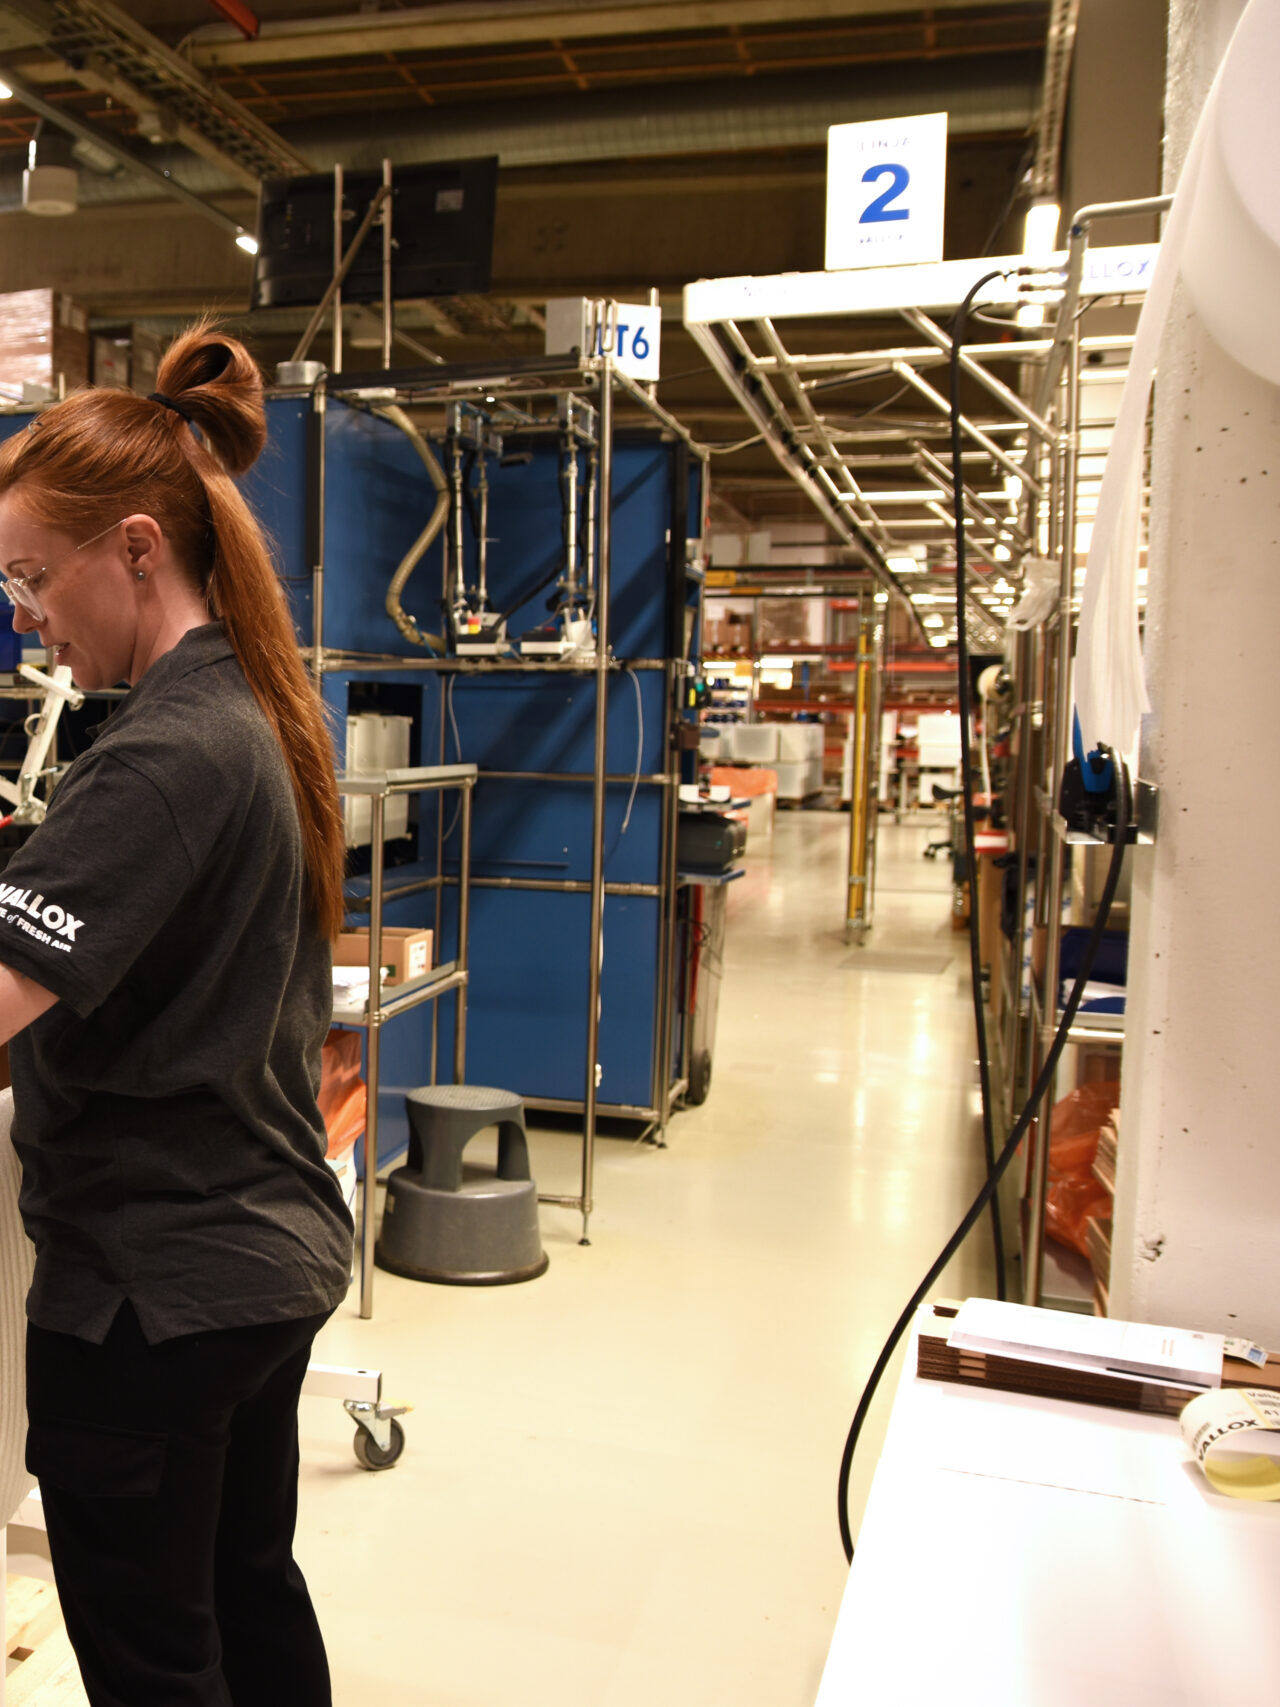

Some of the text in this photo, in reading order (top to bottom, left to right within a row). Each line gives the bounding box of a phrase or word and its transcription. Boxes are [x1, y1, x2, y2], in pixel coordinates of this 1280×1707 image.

[859, 163, 910, 224] 2
[7, 914, 19, 924] of
[17, 917, 52, 945] FRESH
[51, 939, 72, 953] AIR
[1198, 1419, 1258, 1461] VALLOX
